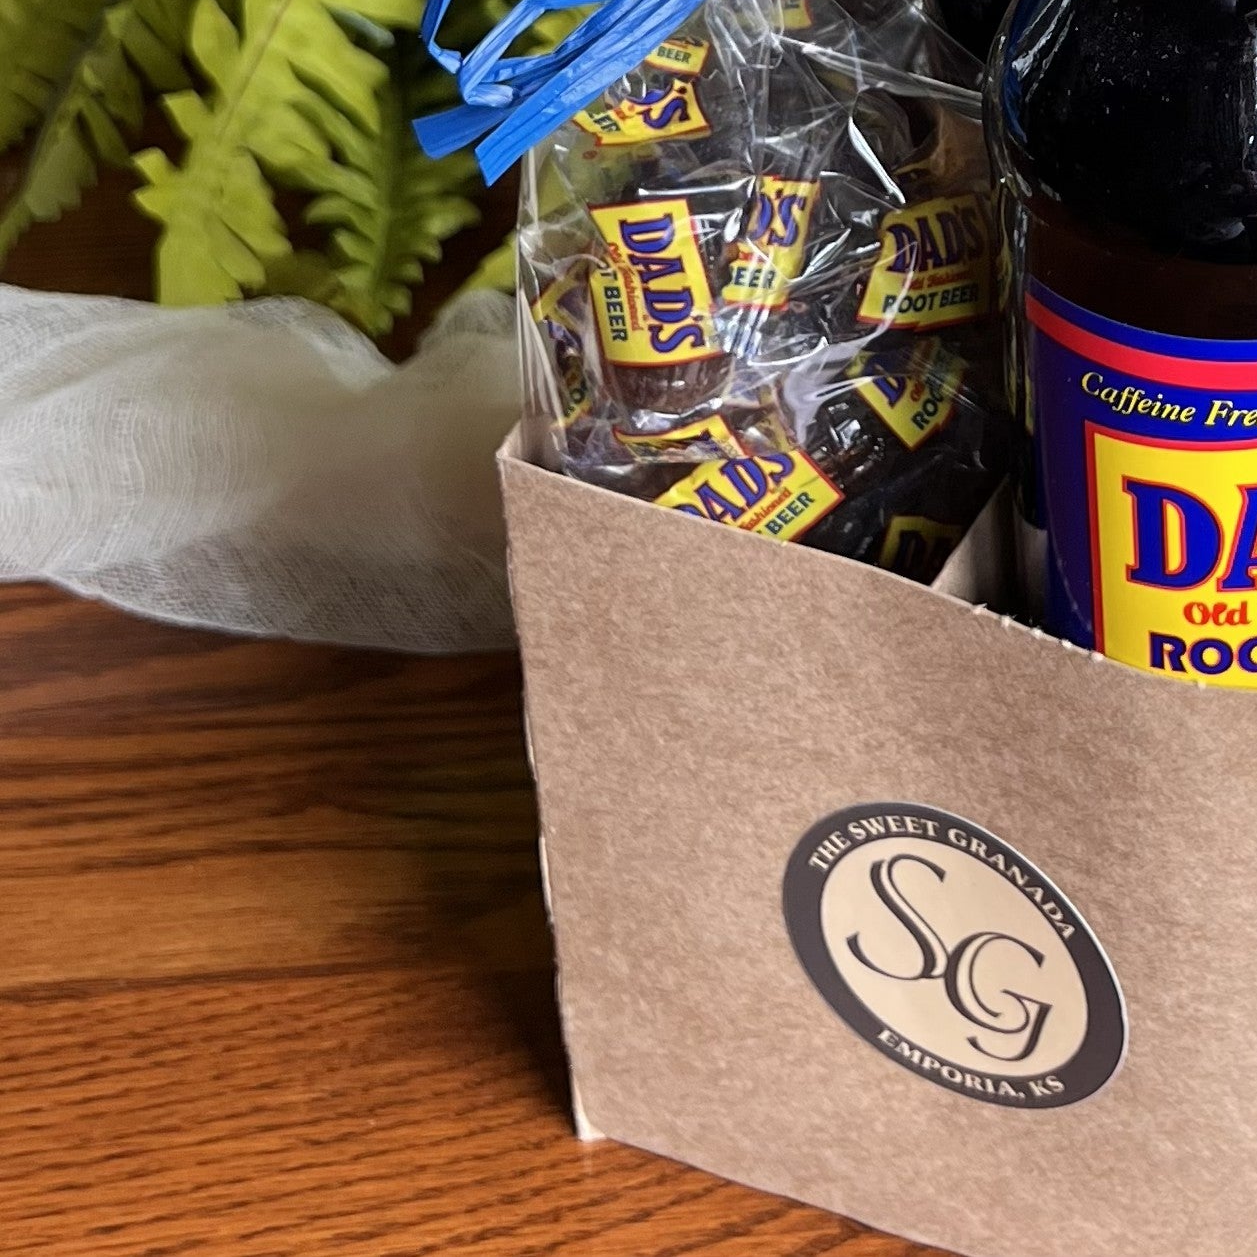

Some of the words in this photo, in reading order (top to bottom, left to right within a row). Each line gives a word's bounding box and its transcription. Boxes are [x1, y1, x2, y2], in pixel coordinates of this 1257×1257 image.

[657, 46, 692, 64] BEER
[618, 213, 705, 353] DAD'S
[604, 286, 628, 341] BEER
[1081, 371, 1196, 424] Caffeine
[765, 491, 815, 535] BEER
[1183, 601, 1250, 627] Old
[809, 830, 851, 873] THE
[847, 815, 939, 842] SWEET
[947, 827, 1077, 941] GRANADA
[1029, 1075, 1066, 1097] KS
